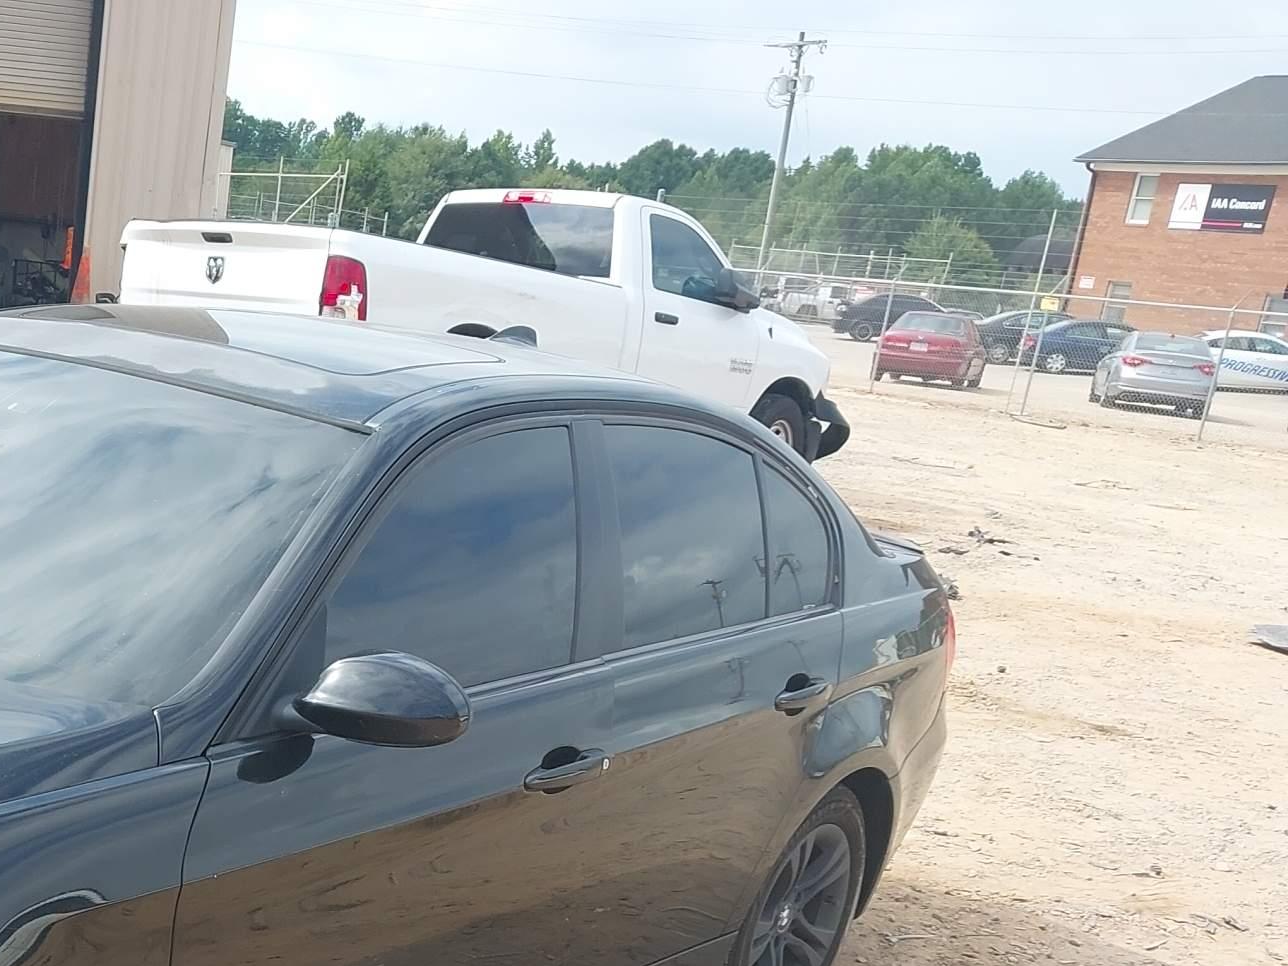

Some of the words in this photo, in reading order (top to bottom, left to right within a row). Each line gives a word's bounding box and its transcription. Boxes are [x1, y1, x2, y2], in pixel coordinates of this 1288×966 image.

[1211, 198, 1228, 209] IAA
[1229, 199, 1266, 210] Concord
[1220, 358, 1288, 382] PROGRESSIV
